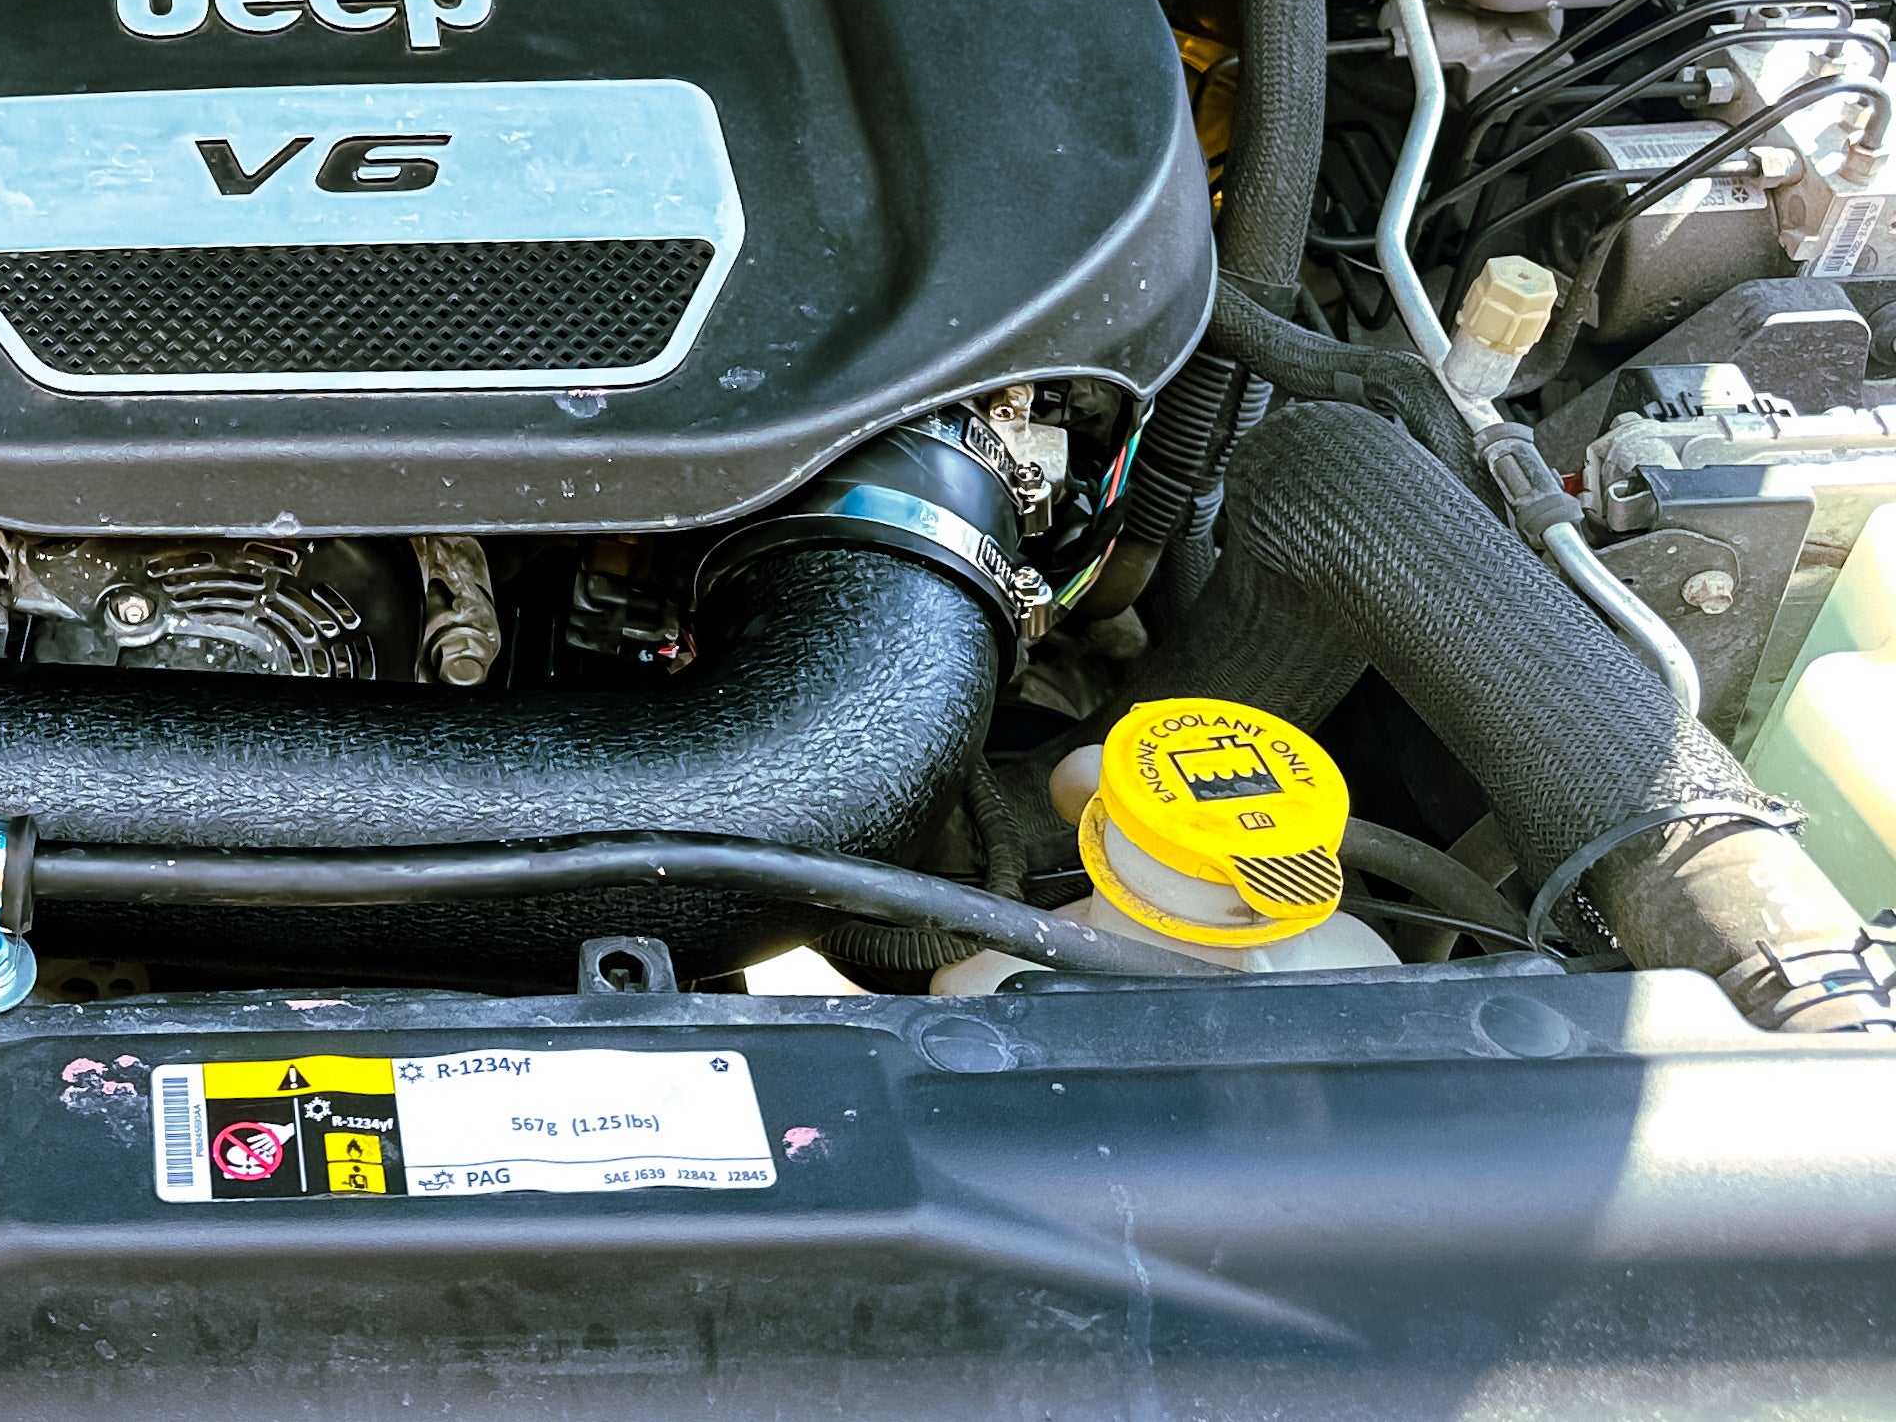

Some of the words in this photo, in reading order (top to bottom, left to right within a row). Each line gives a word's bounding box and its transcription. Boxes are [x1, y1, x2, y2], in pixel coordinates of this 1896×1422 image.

[194, 133, 453, 196] V6
[1150, 714, 1267, 738] COOLANT
[1137, 738, 1178, 804] ENGINE
[1271, 739, 1315, 788] ONLY
[436, 1055, 532, 1081] R-1234yf
[332, 1114, 394, 1133] R-1234yf
[512, 1116, 559, 1136] 567g
[571, 1114, 622, 1136] (1.25
[624, 1112, 661, 1133] lbs)
[466, 1167, 512, 1188] PAG
[604, 1170, 632, 1185] SAE
[634, 1166, 666, 1182] J639
[677, 1168, 718, 1183] J2842
[726, 1168, 768, 1183] J2845
